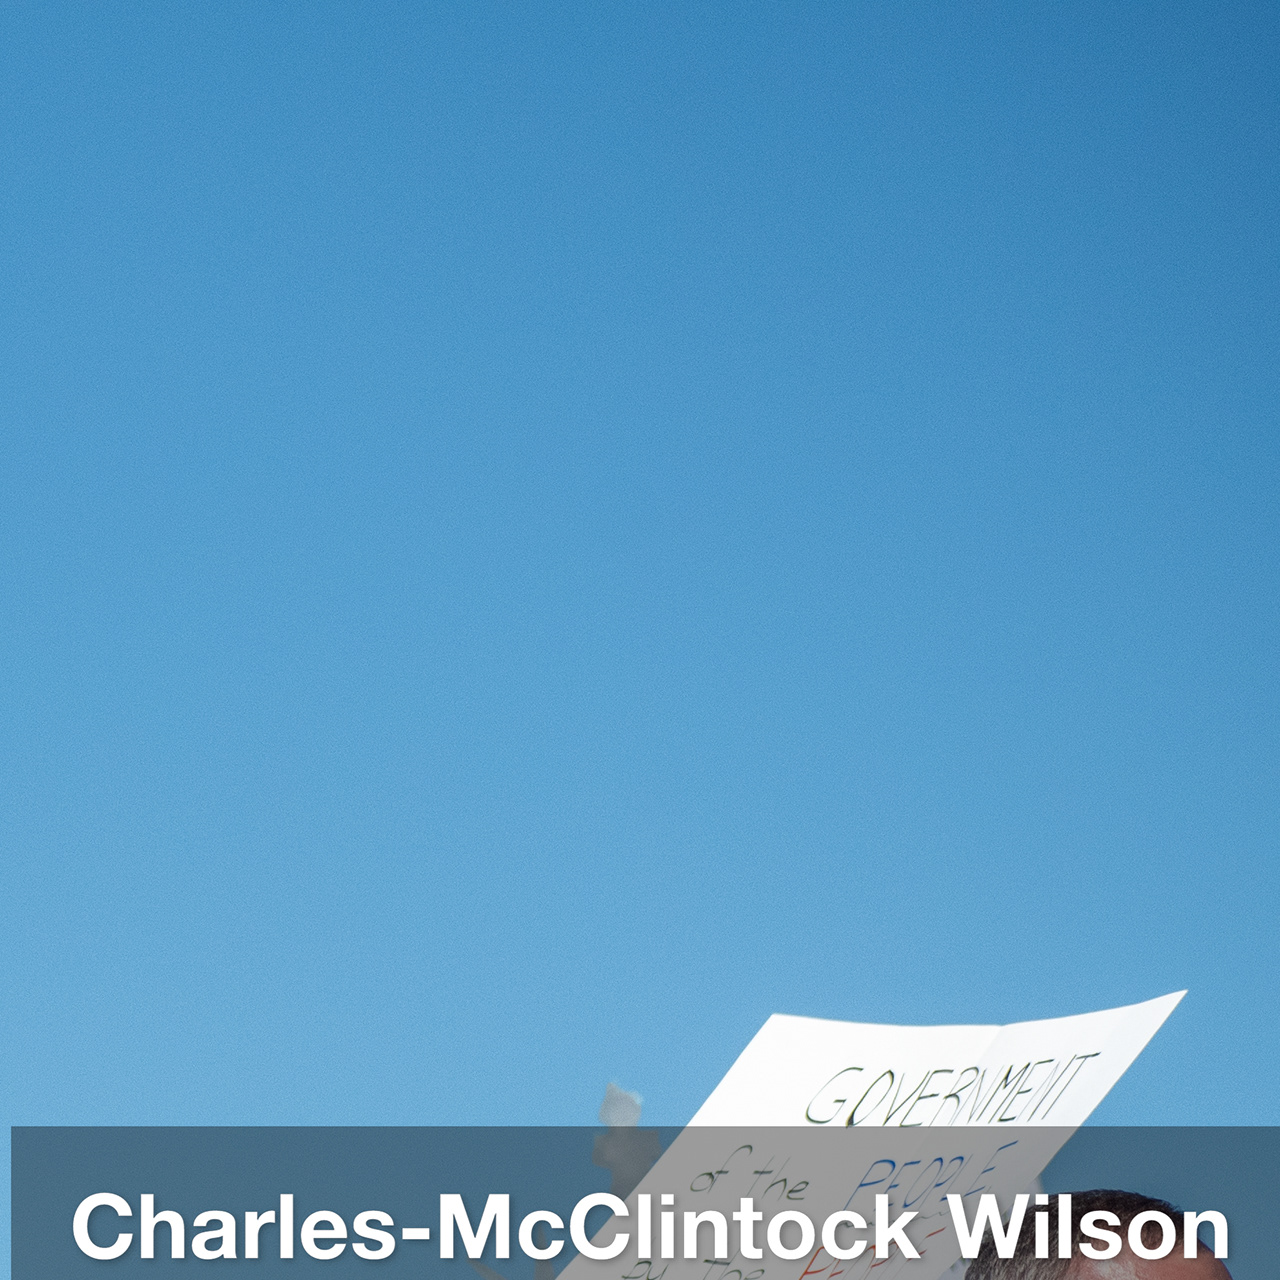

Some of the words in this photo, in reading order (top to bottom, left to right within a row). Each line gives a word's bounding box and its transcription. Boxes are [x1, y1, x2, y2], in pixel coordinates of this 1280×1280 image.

[805, 1052, 1102, 1129] GOVERNMENT
[690, 1144, 753, 1193] of
[745, 1154, 810, 1201] the
